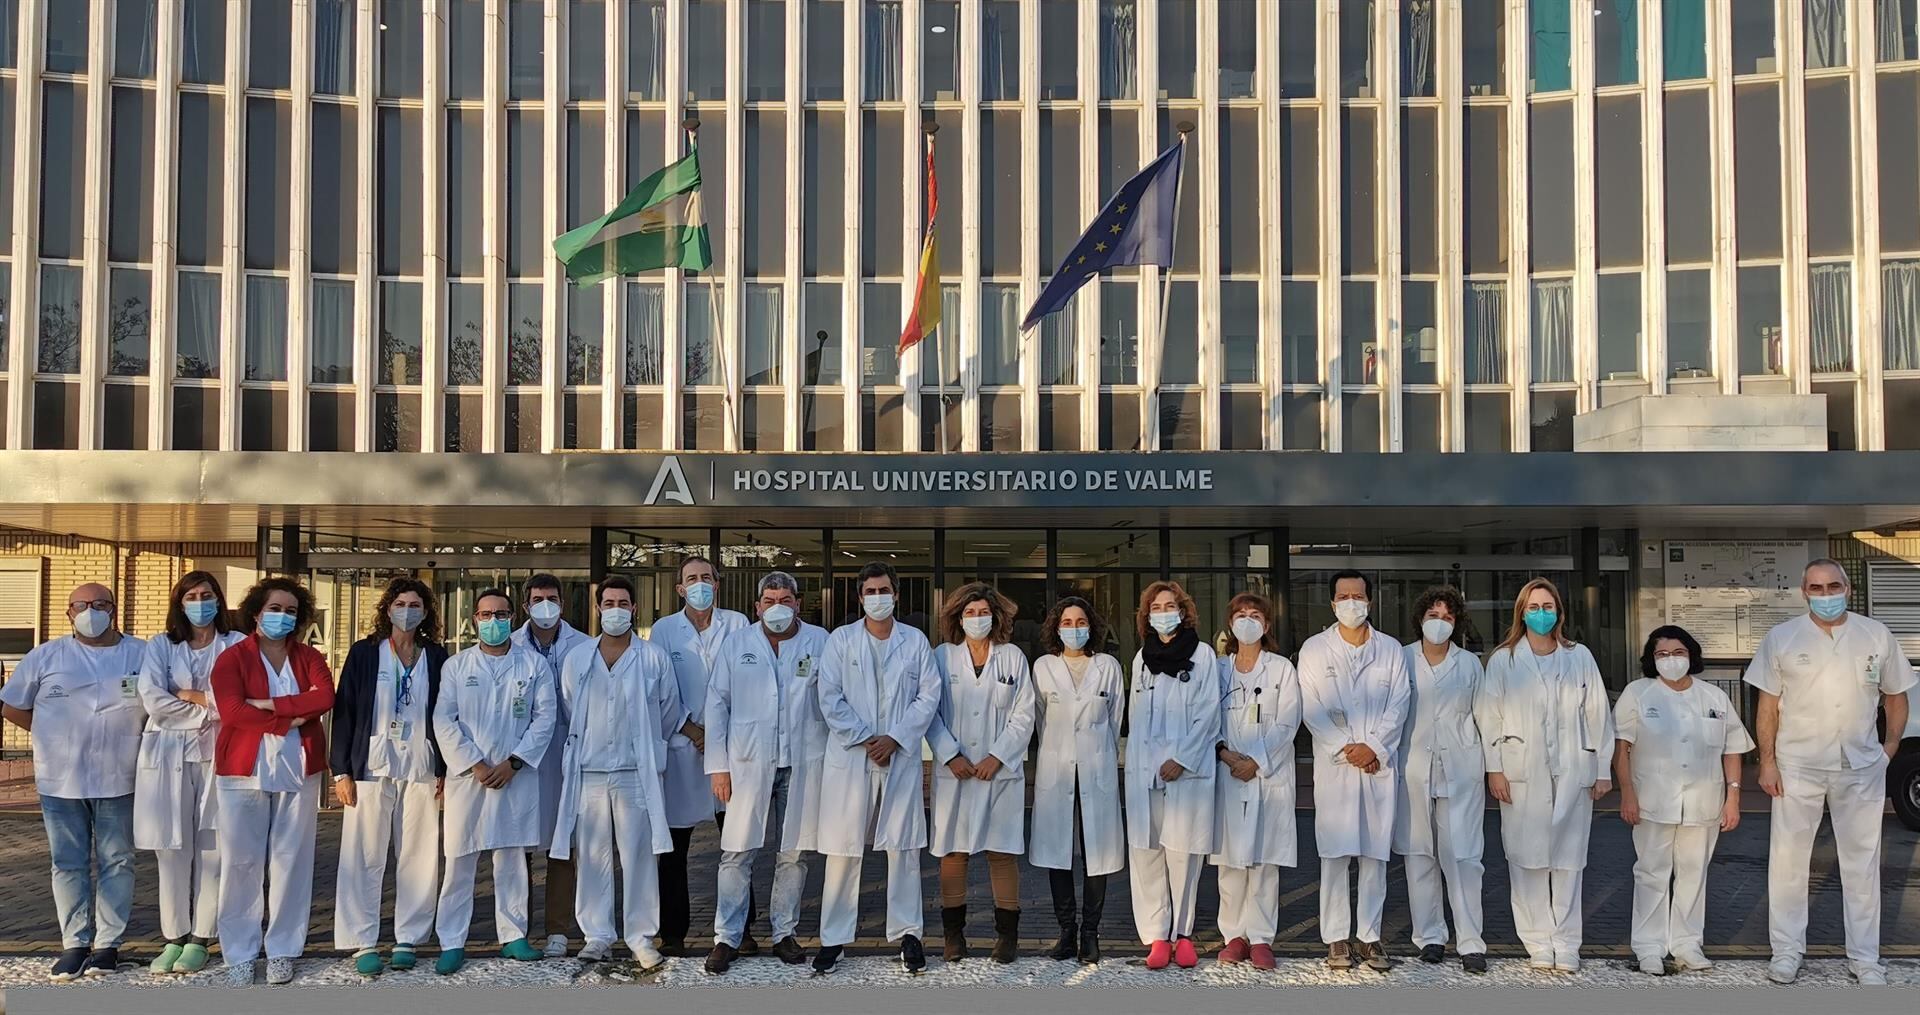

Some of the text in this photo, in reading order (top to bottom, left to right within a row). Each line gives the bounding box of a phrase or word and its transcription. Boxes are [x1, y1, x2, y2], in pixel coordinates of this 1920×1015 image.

[733, 470, 1213, 491] HOSPITAL UNIVERSITARIO DE VALME
